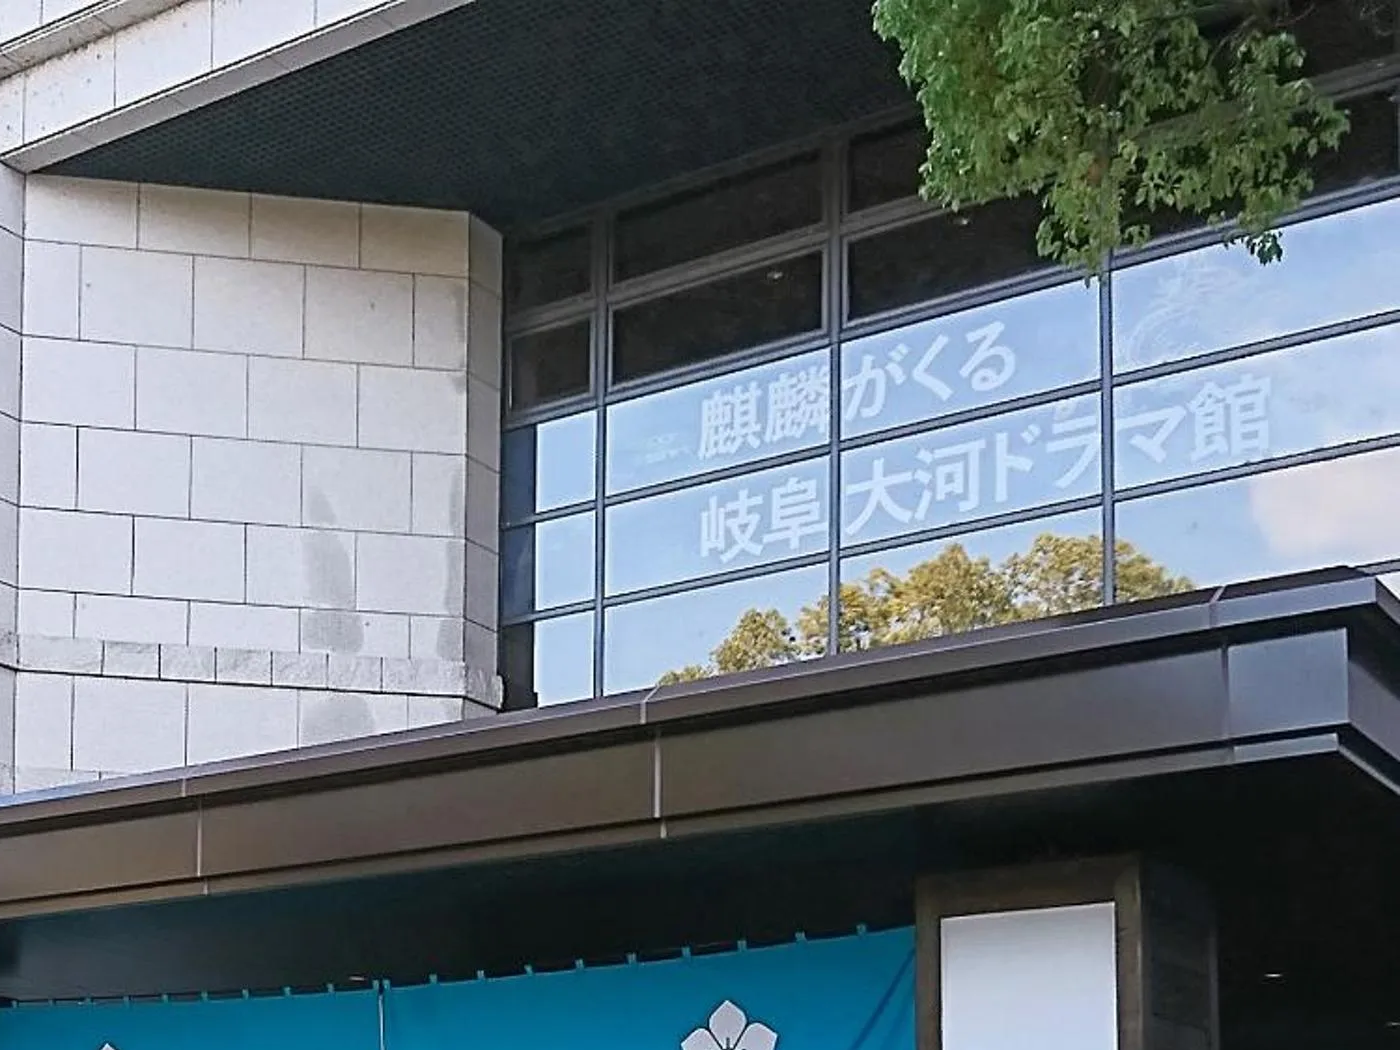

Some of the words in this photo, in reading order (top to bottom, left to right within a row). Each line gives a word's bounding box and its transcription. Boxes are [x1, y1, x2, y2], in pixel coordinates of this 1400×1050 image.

[699, 321, 1016, 460] 麒麟がくる
